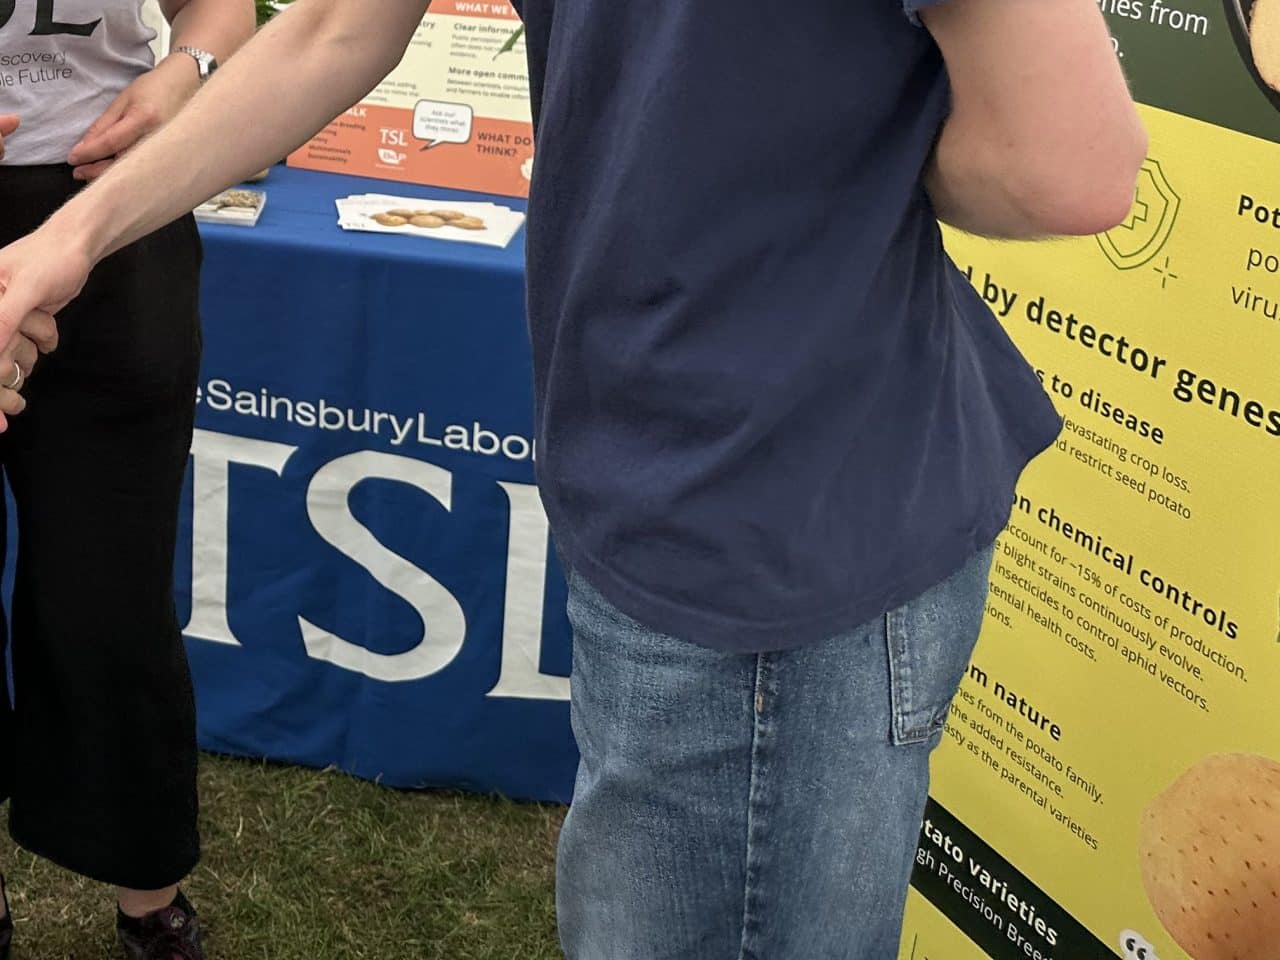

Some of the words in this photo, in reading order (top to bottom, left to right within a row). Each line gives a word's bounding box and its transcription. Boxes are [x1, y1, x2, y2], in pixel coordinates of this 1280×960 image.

[1149, 0, 1209, 36] from
[18, 66, 73, 86] Future
[380, 128, 409, 147] TSL
[477, 132, 512, 145] WHAT
[477, 145, 518, 158] THINK?
[982, 273, 1018, 317] by
[1026, 297, 1167, 379] detector
[1173, 367, 1280, 437] genes
[1051, 374, 1073, 399] to
[1080, 389, 1164, 445] disease
[1070, 445, 1112, 478] restrict
[1115, 470, 1146, 494] seed
[1148, 489, 1191, 520] potato
[1131, 452, 1159, 477] crop
[1162, 466, 1191, 493] loss.
[181, 427, 573, 701] TSL
[1038, 508, 1134, 575] chemical
[1139, 569, 1240, 640] controls
[995, 561, 1060, 611] insecticides
[1062, 605, 1074, 620] to
[1077, 616, 1119, 651] control
[1121, 645, 1158, 676] aphid
[1160, 670, 1210, 713] vectors.
[1003, 543, 1036, 572] blight
[1038, 566, 1076, 598] strains
[1079, 591, 1157, 651] continuously
[1159, 644, 1204, 681] evolve.
[1027, 604, 1063, 638] health
[1065, 632, 1097, 662] costs.
[1050, 547, 1068, 566] for
[1070, 563, 1102, 589] ~15%
[1104, 583, 1118, 598] of
[1120, 593, 1152, 619] costs
[1154, 615, 1169, 630] of
[1170, 626, 1248, 683] production.
[994, 682, 1062, 741] nature
[951, 704, 968, 724] the
[970, 719, 1003, 751] added
[1006, 747, 1064, 799] resistance.
[977, 700, 1003, 727] from
[1006, 721, 1024, 742] the
[1026, 737, 1063, 772] potato
[1066, 767, 1104, 805] family.
[967, 740, 980, 756] as
[981, 750, 999, 772] the
[1000, 767, 1048, 809] parental
[1049, 805, 1099, 850] varieties
[920, 819, 964, 864] tato
[968, 857, 1059, 946] varieties
[938, 862, 1004, 930] Precision
